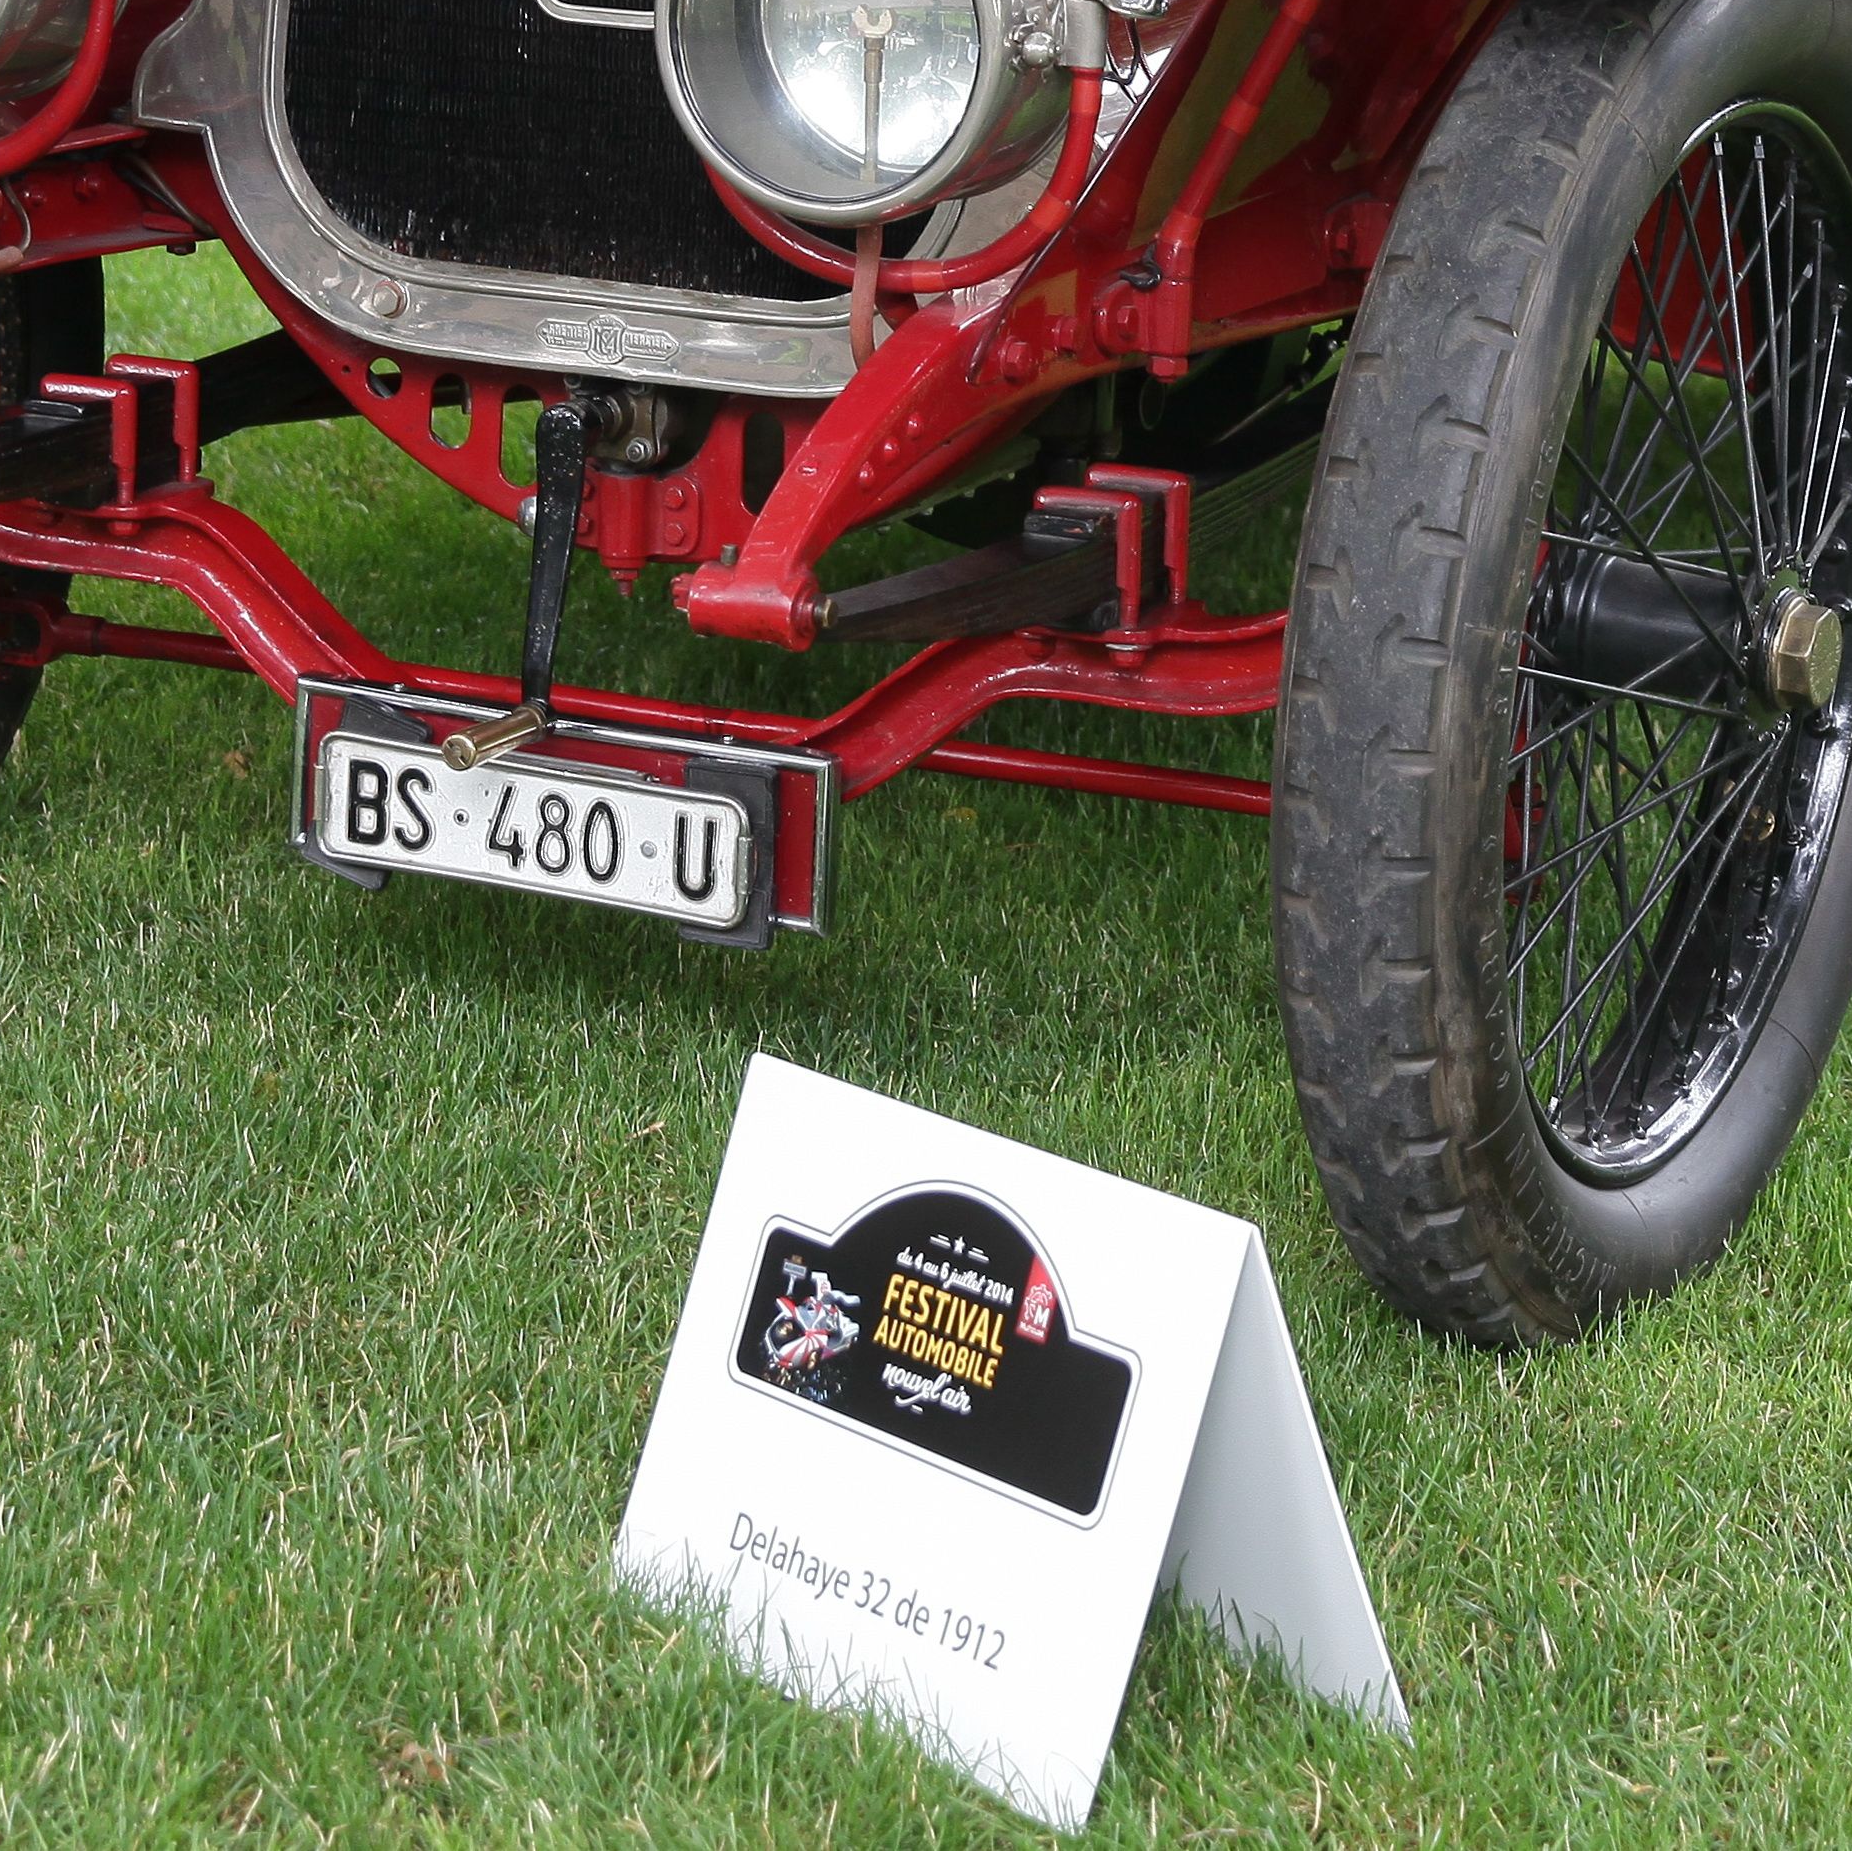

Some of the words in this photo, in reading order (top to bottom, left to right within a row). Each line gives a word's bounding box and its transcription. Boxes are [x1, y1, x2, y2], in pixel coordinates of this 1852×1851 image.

[348, 758, 433, 852] BS
[488, 780, 622, 884] 480
[674, 813, 716, 902] U
[1505, 1132, 1618, 1296] MICHELIN
[897, 1246, 913, 1266] du
[914, 1252, 924, 1270] 4
[923, 1261, 939, 1276] au
[940, 1261, 950, 1280] 6
[943, 1267, 985, 1293] juillet
[984, 1277, 1015, 1305] 2014
[883, 1273, 1003, 1354] FESTIVAL
[873, 1315, 998, 1388] AUTOMOBILE
[729, 1512, 851, 1600] Delahaye
[854, 1570, 891, 1618] 32
[894, 1589, 930, 1636] de
[939, 1608, 1006, 1670] 1912
